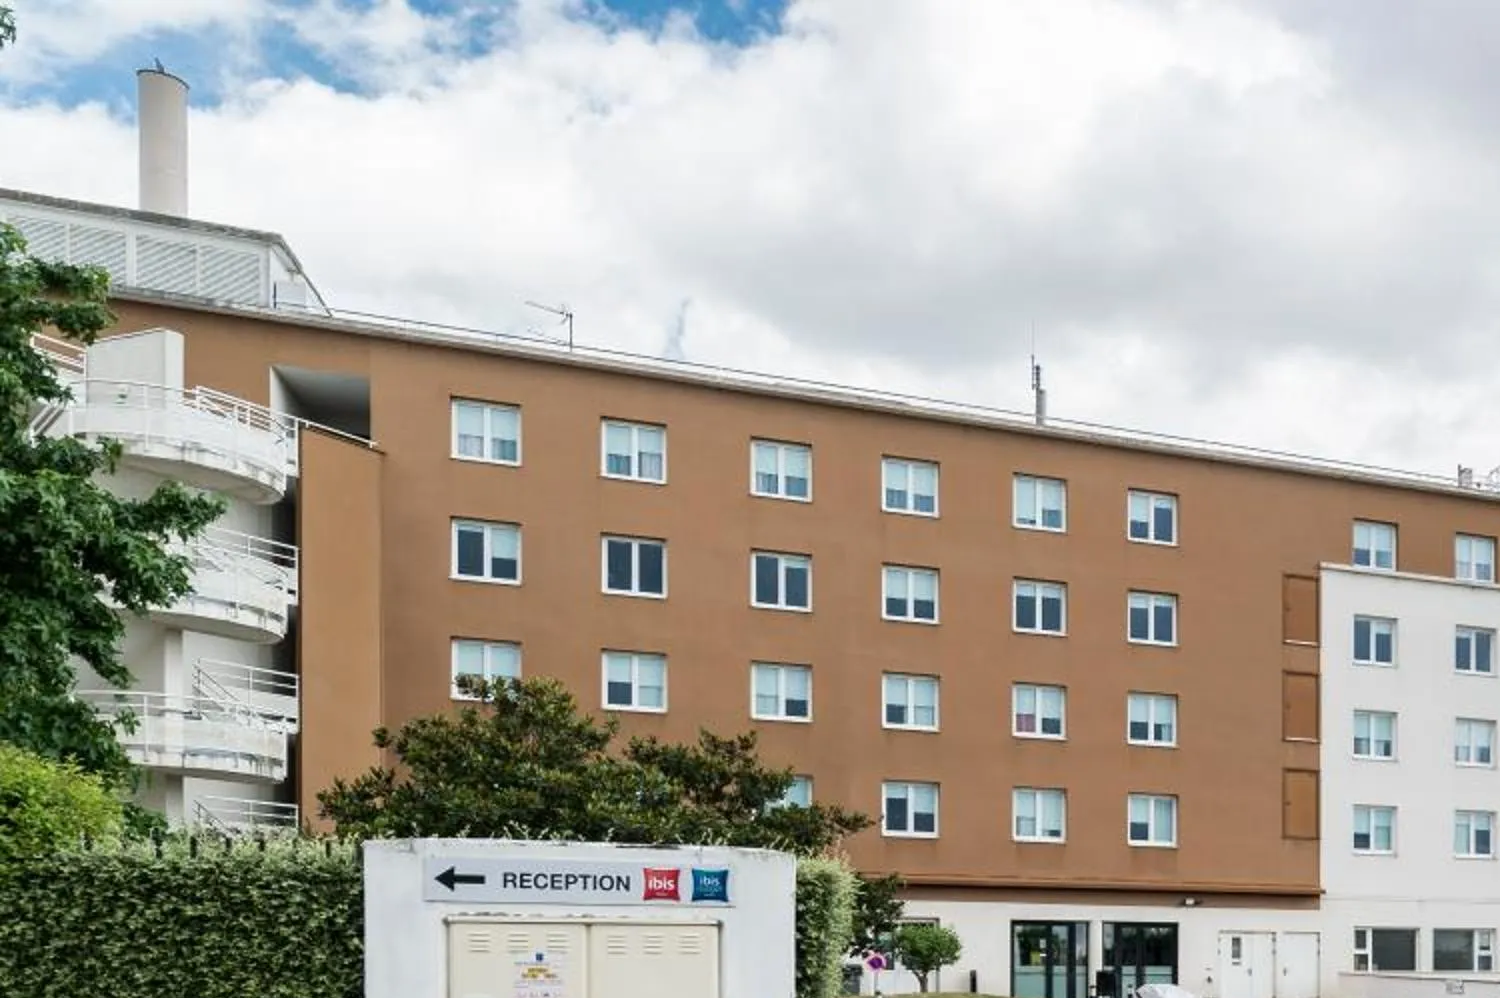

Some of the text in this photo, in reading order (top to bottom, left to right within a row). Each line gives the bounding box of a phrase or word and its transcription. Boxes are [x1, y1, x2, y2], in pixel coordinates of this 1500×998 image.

[502, 872, 631, 892] RECEPTION
[648, 876, 675, 891] ibis
[699, 875, 720, 887] ibis
